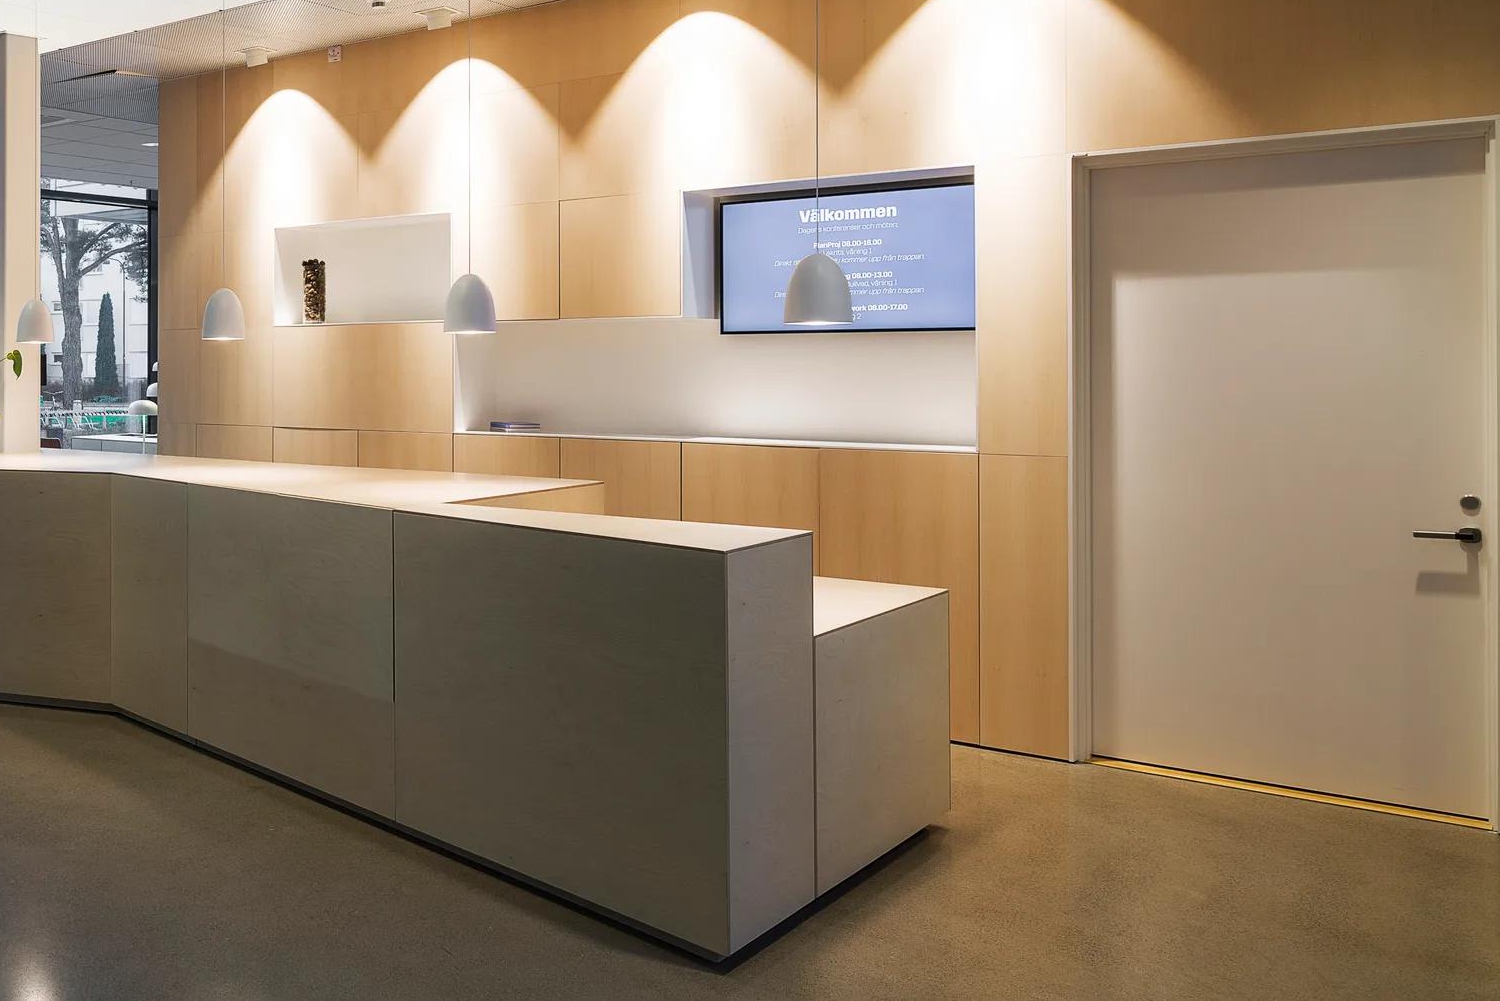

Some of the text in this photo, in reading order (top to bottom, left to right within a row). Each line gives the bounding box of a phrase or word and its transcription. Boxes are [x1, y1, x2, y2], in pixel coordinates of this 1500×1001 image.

[799, 206, 897, 223] Välkommen
[861, 222, 875, 230] och
[846, 247, 868, 255] våning
[868, 255, 881, 263] upp
[871, 279, 893, 287] våning
[868, 288, 881, 296] upp
[882, 286, 897, 294] från
[856, 312, 862, 320] 2
